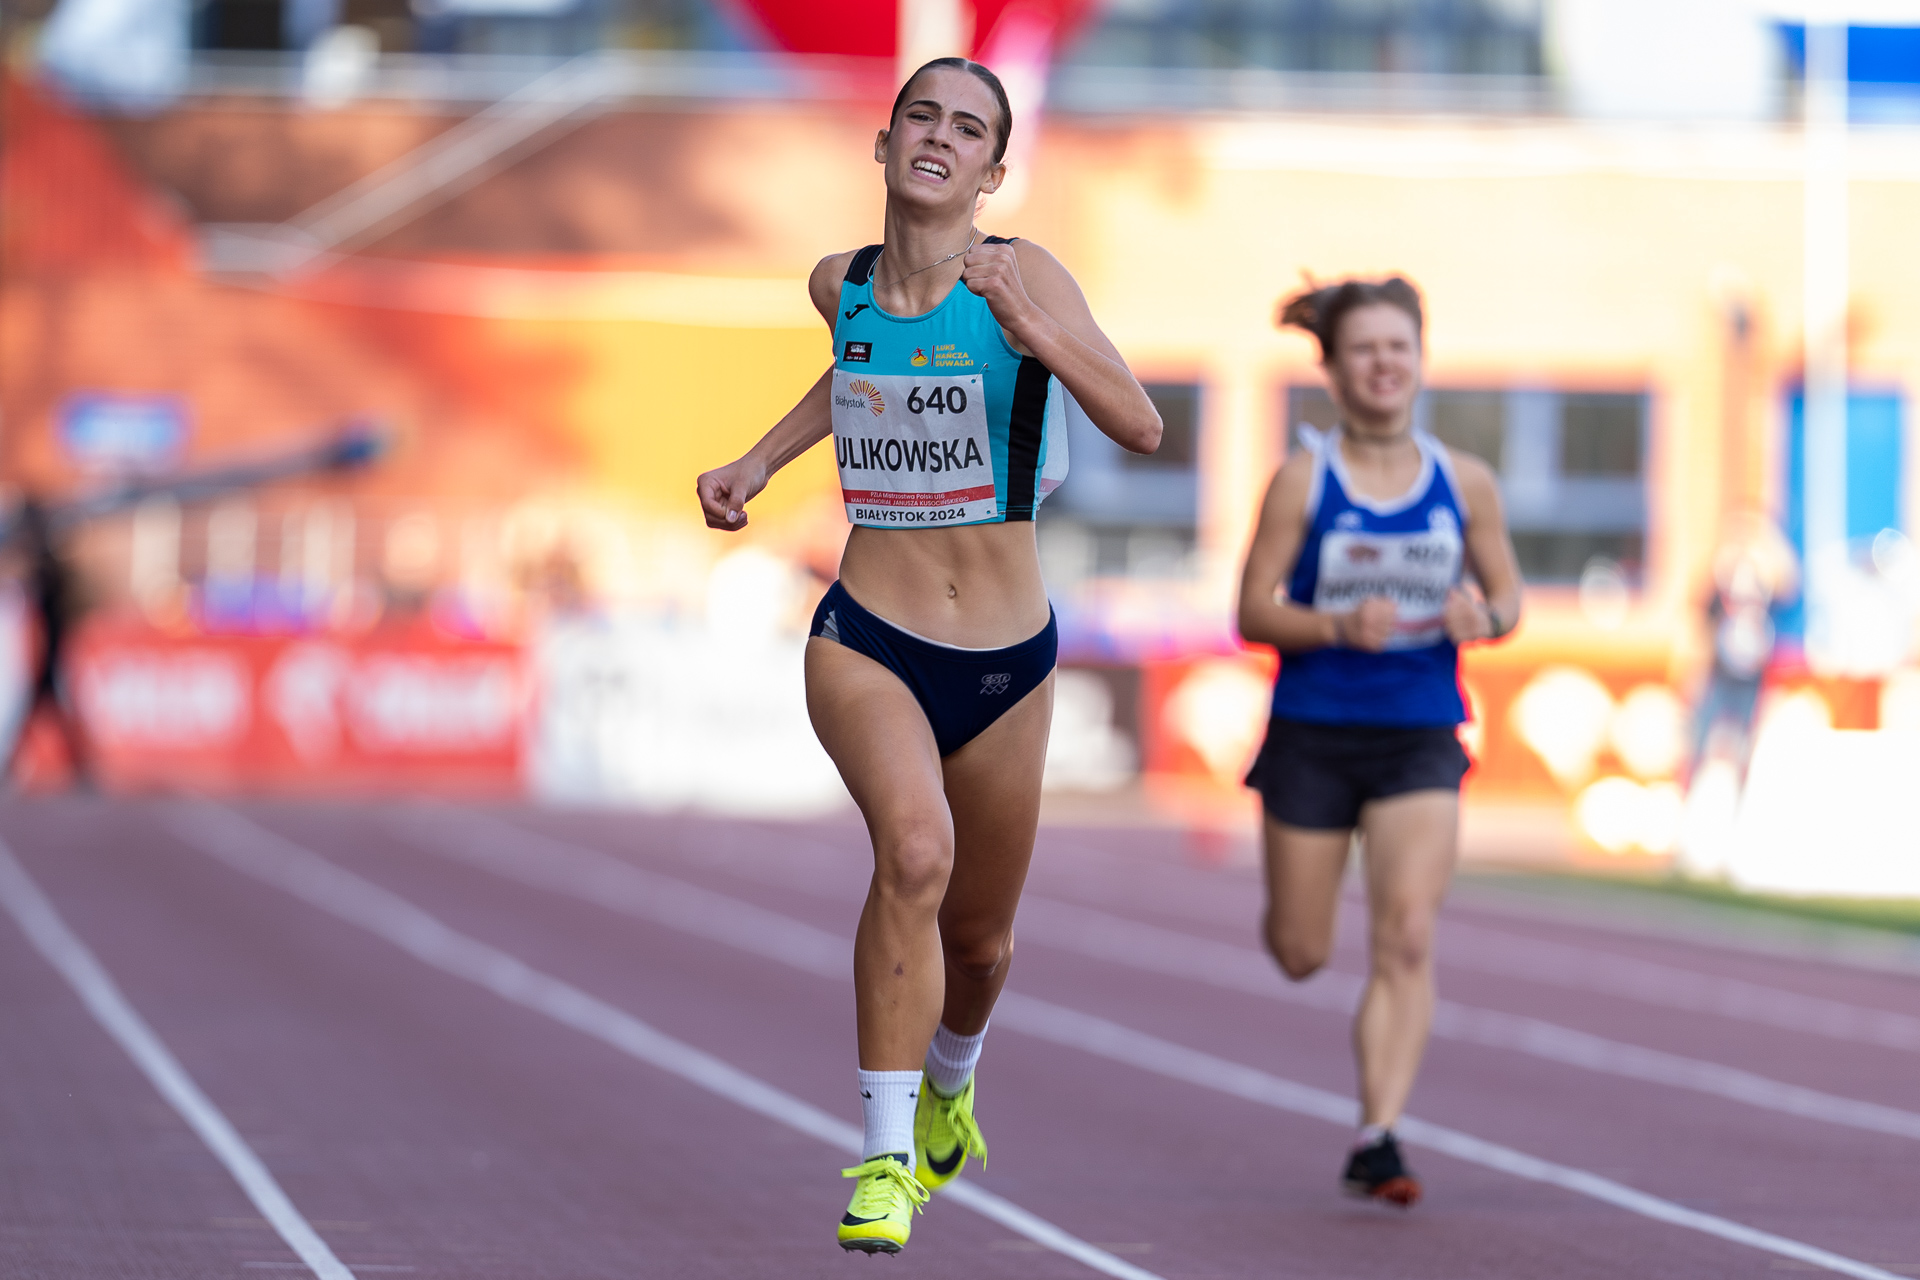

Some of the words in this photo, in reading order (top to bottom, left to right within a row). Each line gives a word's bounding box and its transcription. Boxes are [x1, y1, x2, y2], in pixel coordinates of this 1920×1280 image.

[935, 351, 969, 359] HAŃCZA
[935, 359, 974, 367] SUWAŁKI
[835, 395, 866, 409] Białystok
[907, 386, 967, 415] 640
[856, 508, 926, 522] BIAŁYSTOK
[929, 507, 966, 521] 2024
